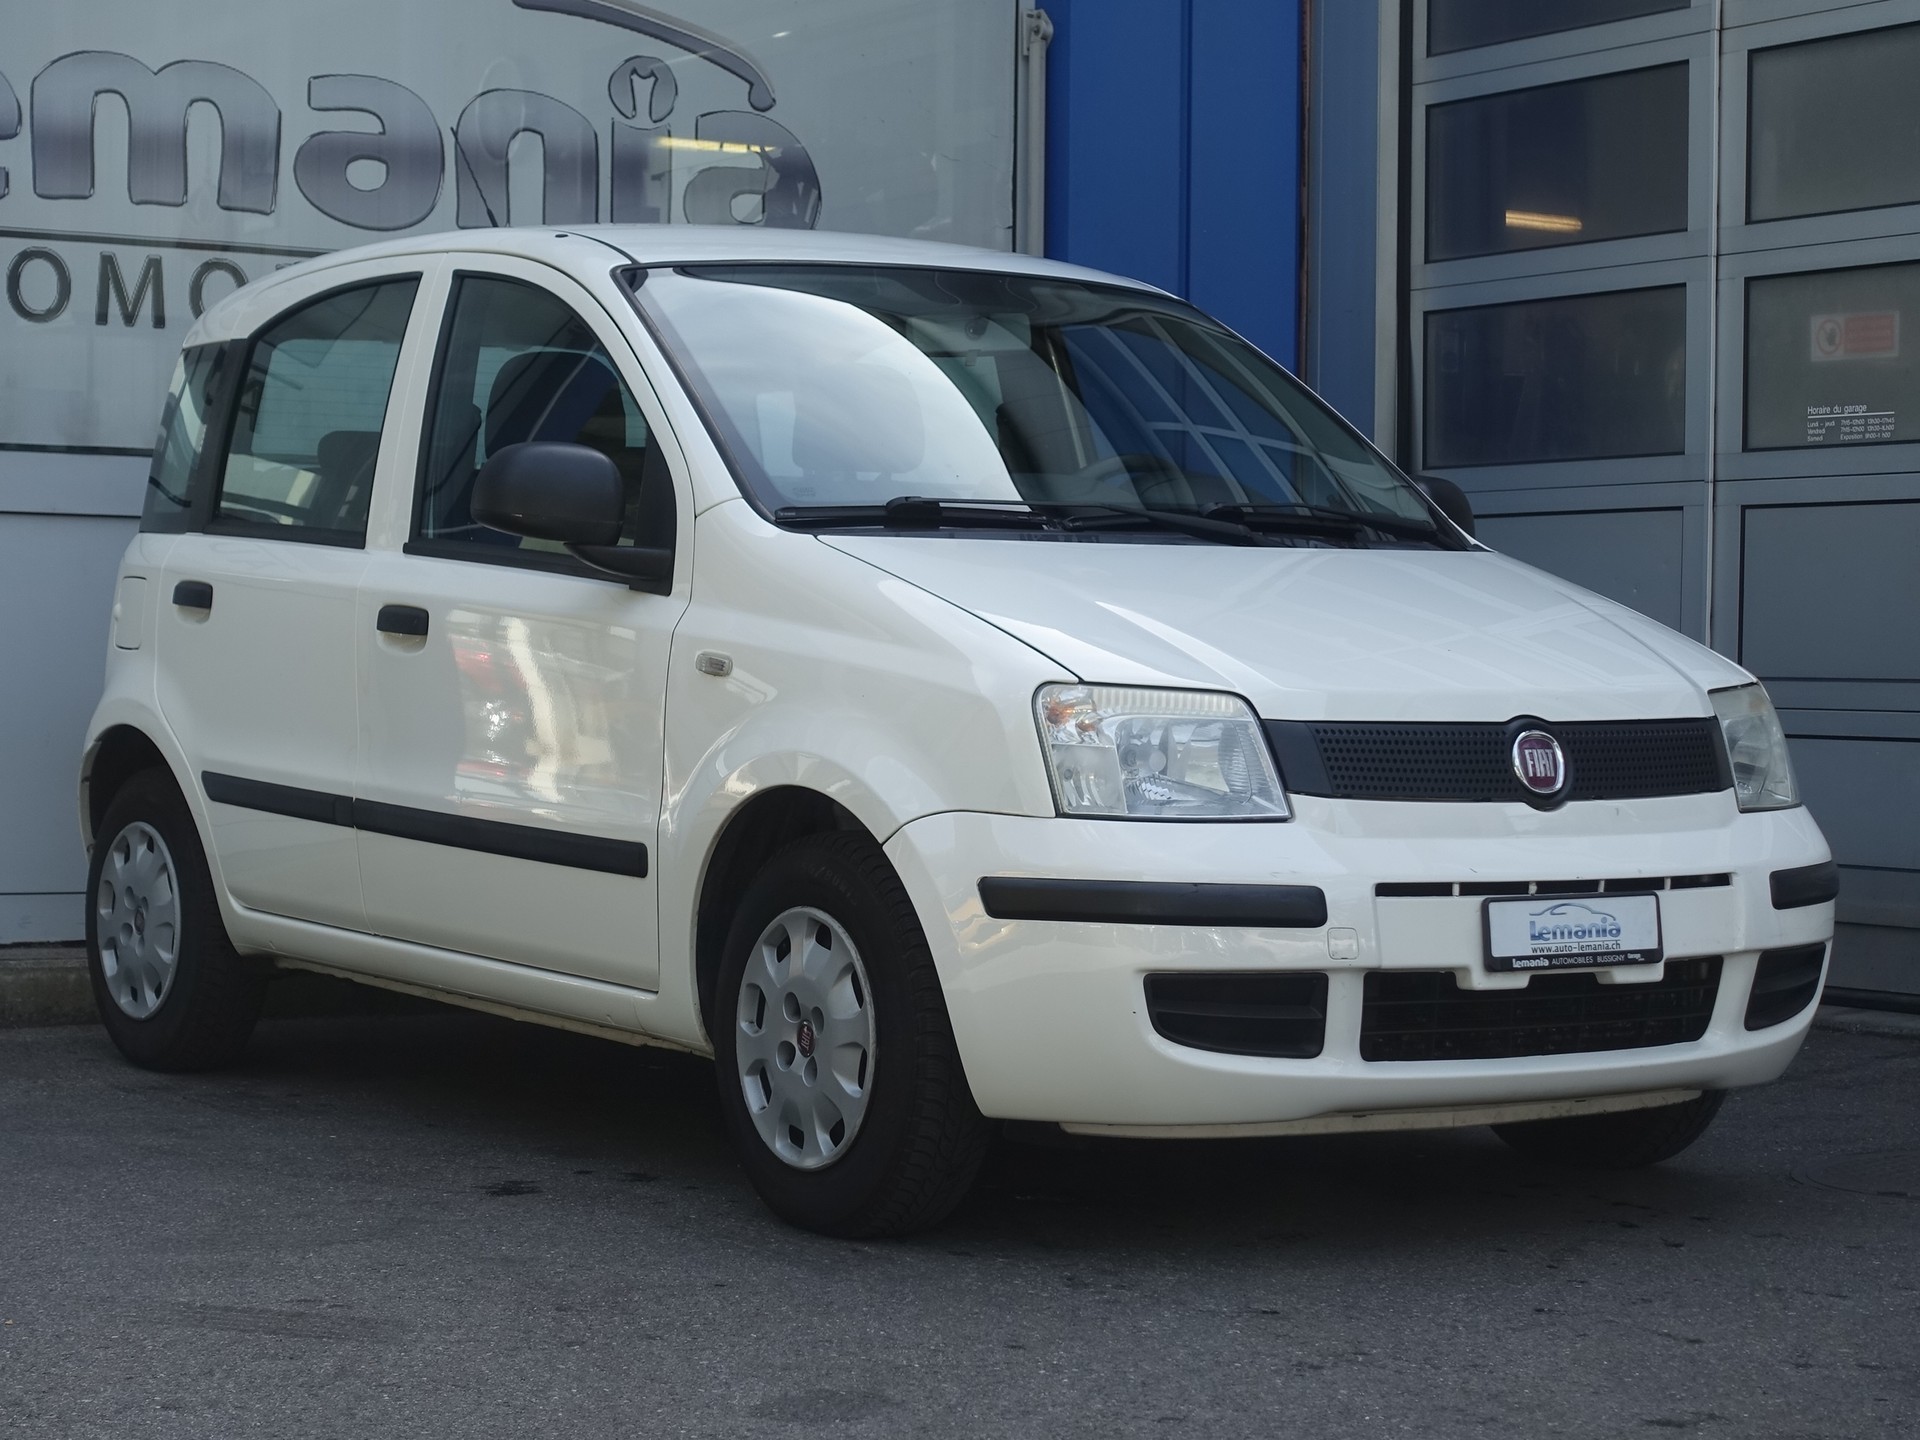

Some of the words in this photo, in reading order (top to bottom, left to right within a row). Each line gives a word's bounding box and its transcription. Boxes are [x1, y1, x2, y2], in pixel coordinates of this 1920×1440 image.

[0, 50, 822, 231] mania
[6, 245, 306, 329] OMO
[1807, 405, 1831, 415] Horaire
[1833, 404, 1842, 414] du
[1844, 404, 1868, 415] garage
[1523, 748, 1555, 777] FIAT
[1529, 916, 1621, 941] Lemania
[1531, 941, 1621, 954] www.auto-lemania.ch
[1512, 957, 1550, 968] Lemania
[1551, 955, 1594, 966] AUTOMOBILES
[1596, 954, 1625, 963] BUSSIGNY
